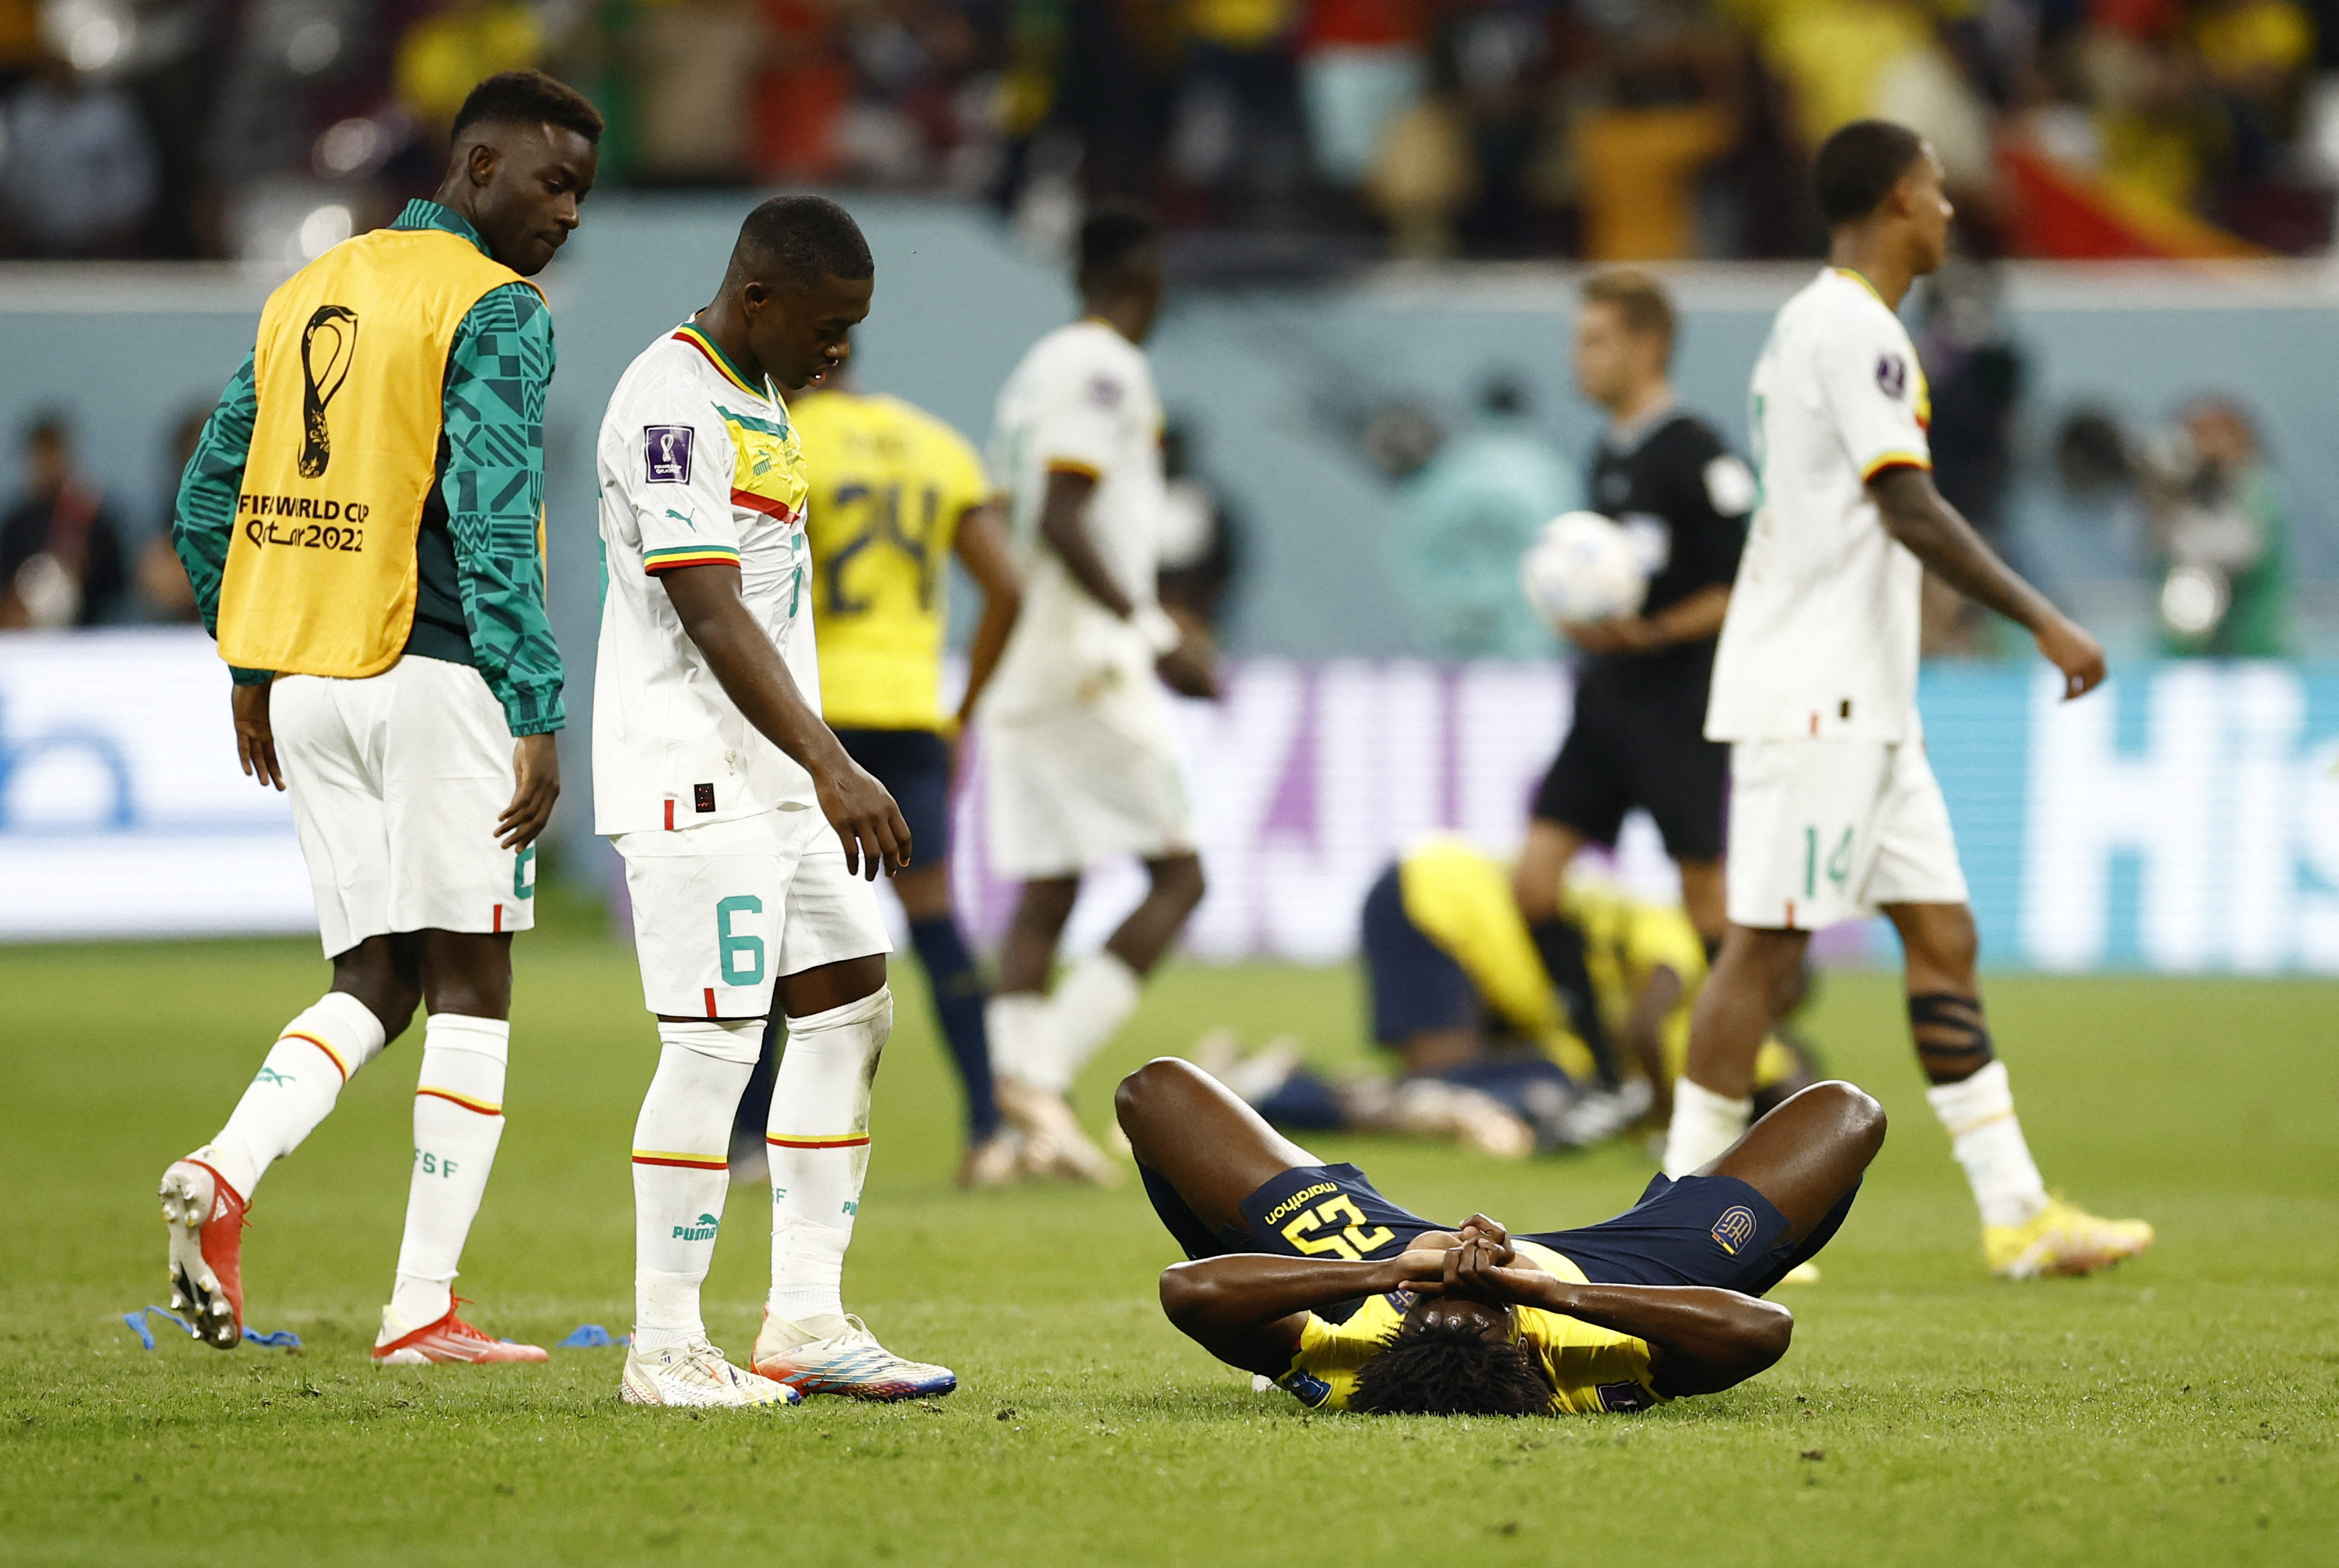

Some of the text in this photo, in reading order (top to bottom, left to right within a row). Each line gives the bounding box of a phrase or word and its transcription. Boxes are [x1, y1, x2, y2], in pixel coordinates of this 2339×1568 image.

[824, 482, 936, 613] 24
[1804, 826, 1854, 900] 14
[716, 895, 765, 986] 6
[672, 1225, 716, 1241] PUMA
[1265, 1182, 1338, 1225] marathon
[1280, 1193, 1396, 1261] 25
